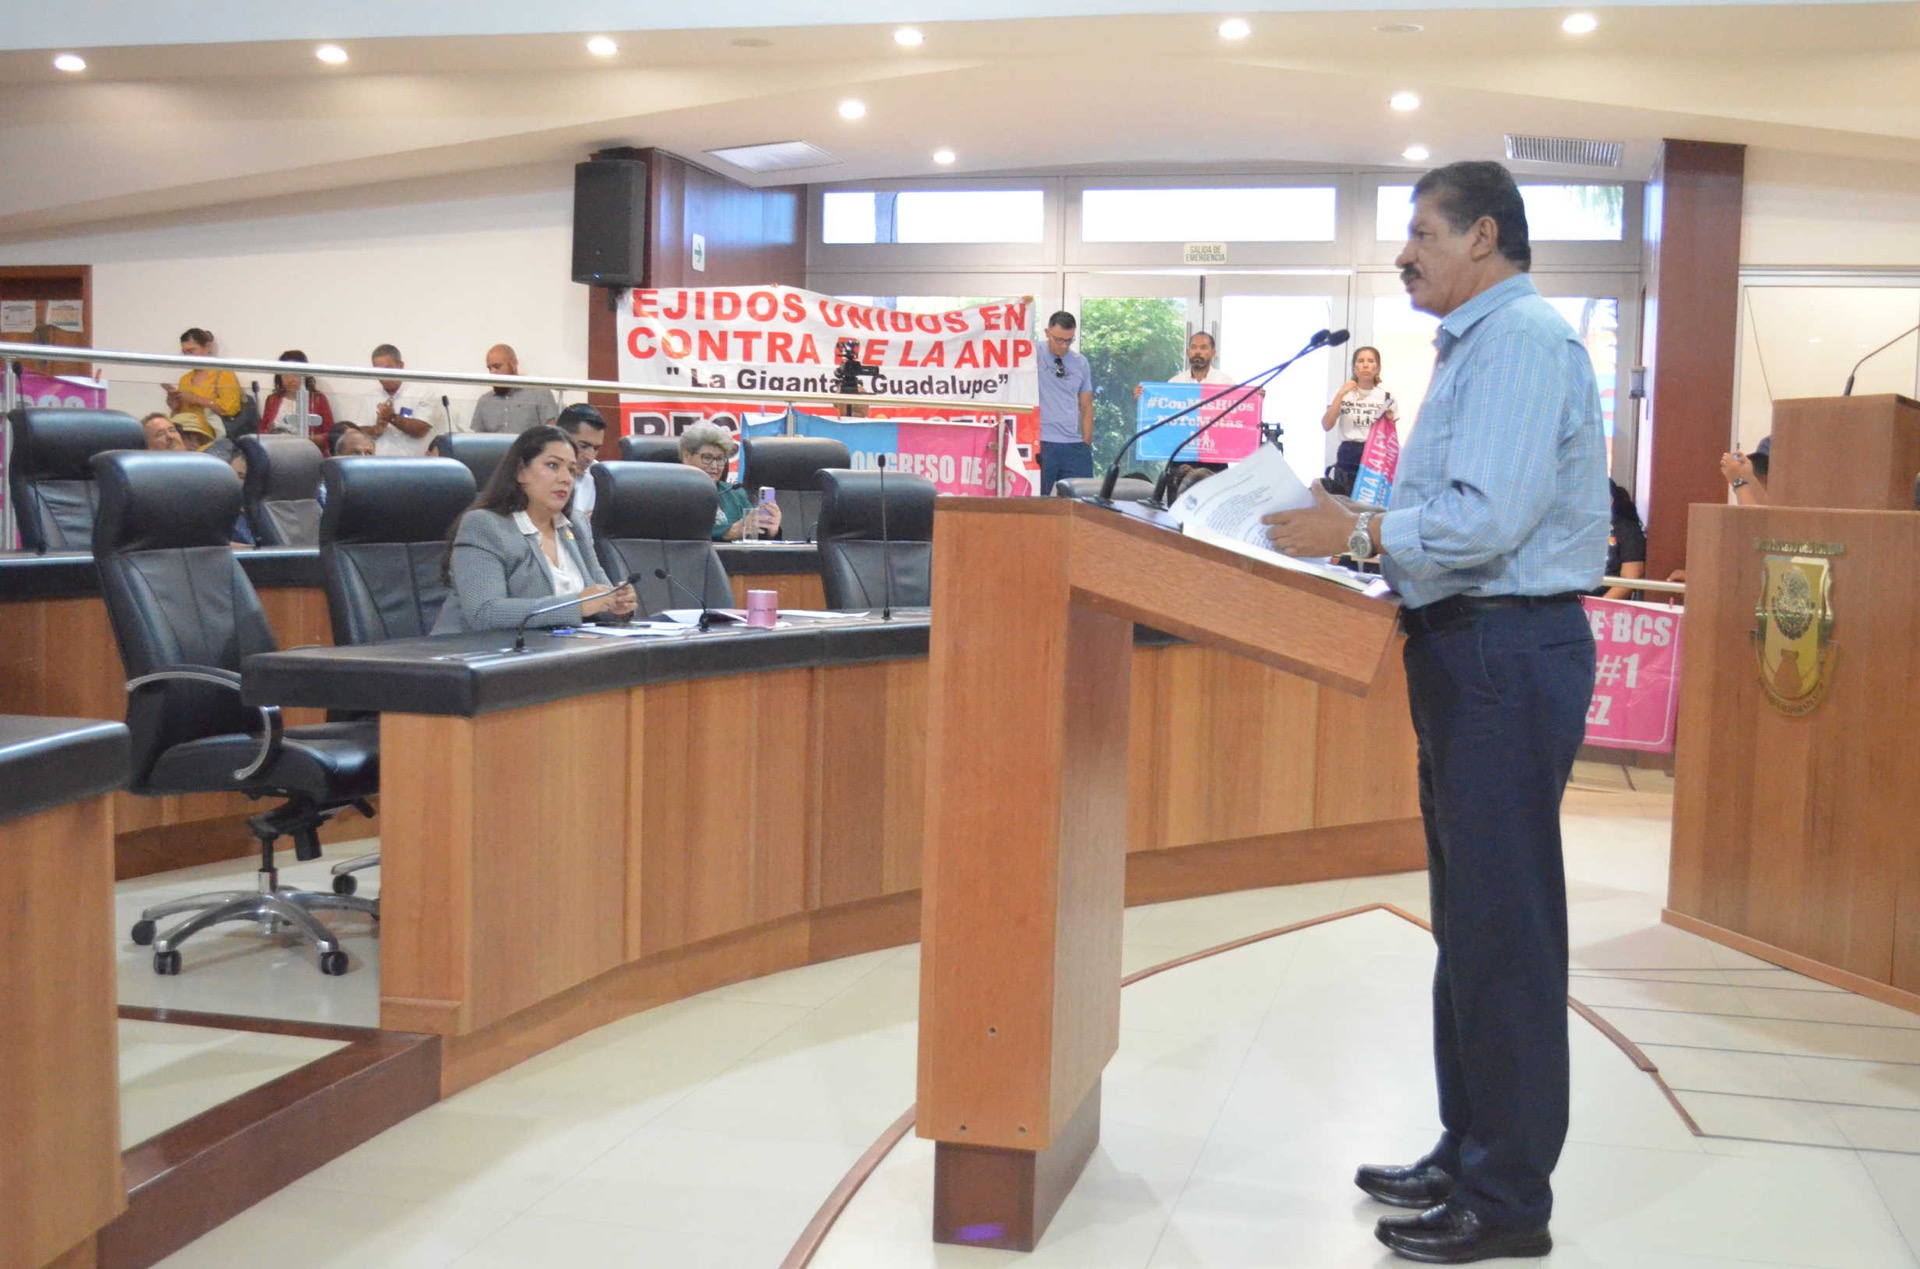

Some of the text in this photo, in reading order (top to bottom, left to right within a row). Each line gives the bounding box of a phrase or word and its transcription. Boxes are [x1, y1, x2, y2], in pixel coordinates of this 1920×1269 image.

[632, 290, 1026, 334] EJIDOS UNIDOS EN
[627, 326, 821, 365] CONTRA
[898, 339, 945, 367] LA
[953, 338, 1033, 368] ANP
[961, 456, 983, 486] DE
[1612, 612, 1673, 647] BCS
